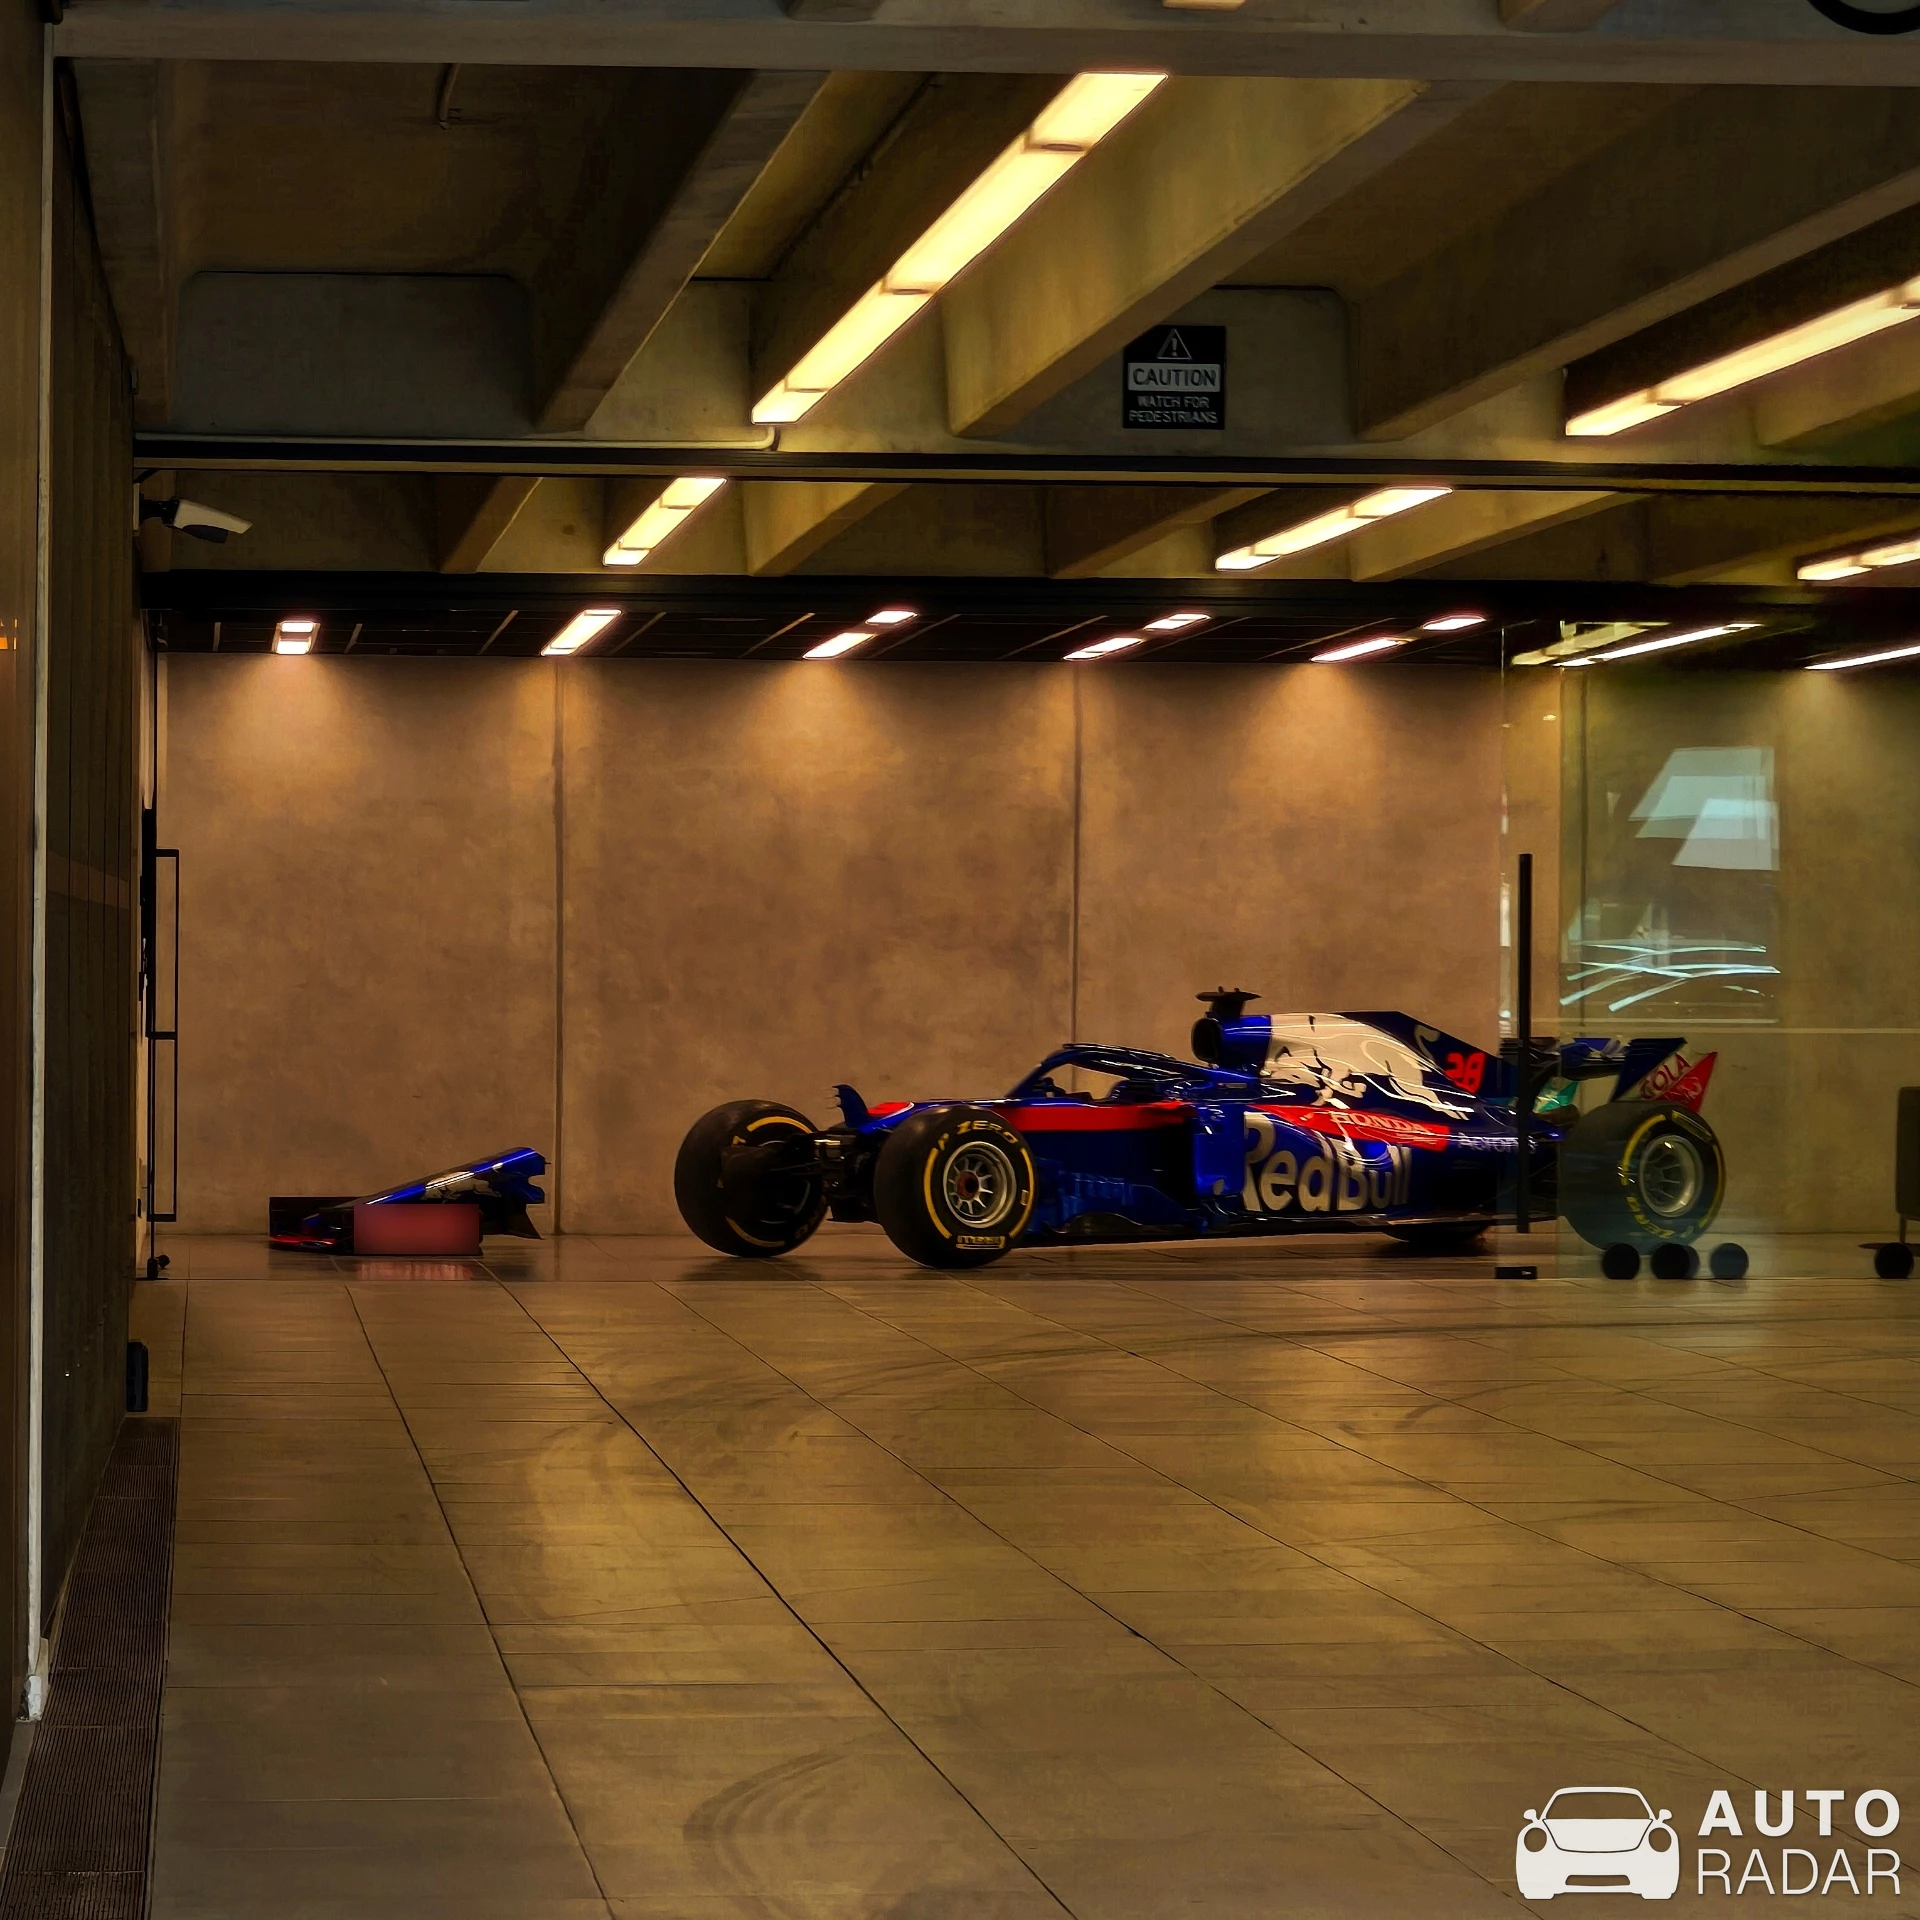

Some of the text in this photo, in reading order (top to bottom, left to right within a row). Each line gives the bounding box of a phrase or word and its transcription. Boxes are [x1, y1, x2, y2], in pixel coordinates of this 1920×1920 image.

[1132, 367, 1217, 387] CAUTION
[1137, 395, 1210, 409] WATCH FOR
[1129, 409, 1218, 424] PEDESTRIANS
[1328, 1110, 1434, 1134] HONDA
